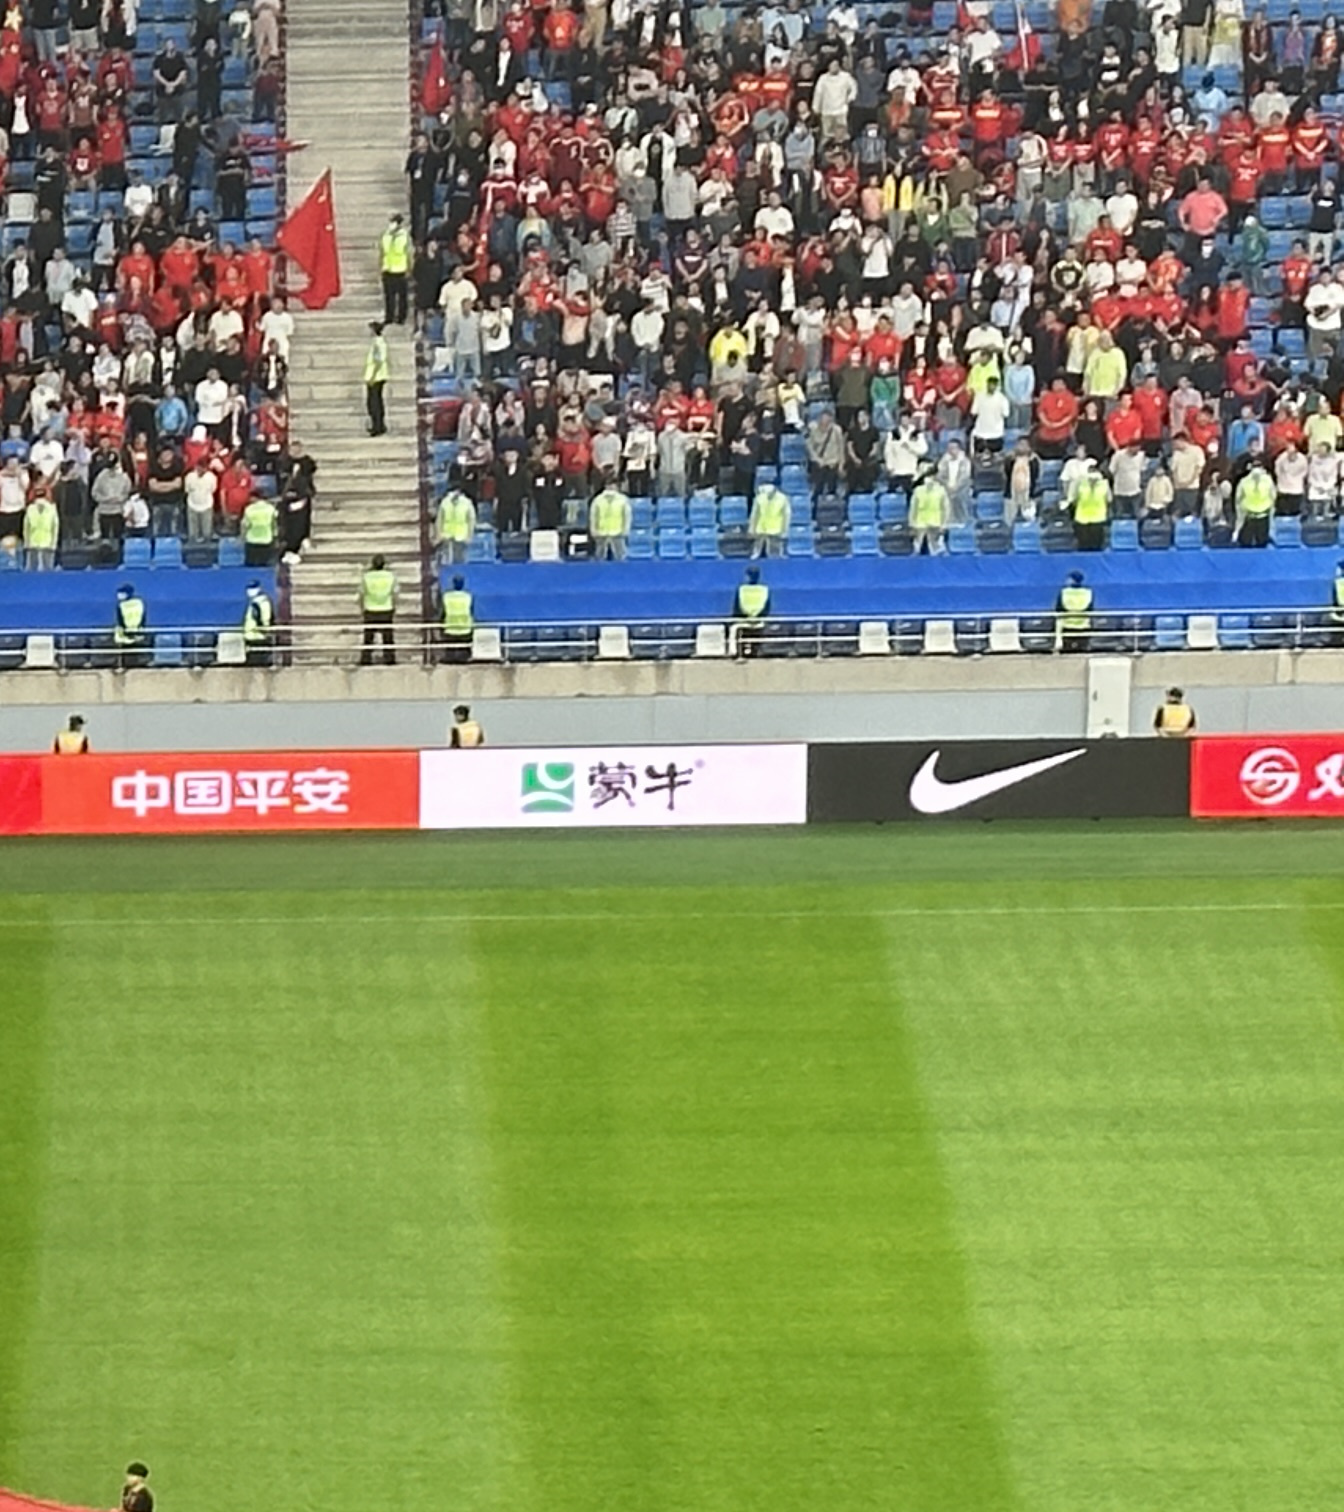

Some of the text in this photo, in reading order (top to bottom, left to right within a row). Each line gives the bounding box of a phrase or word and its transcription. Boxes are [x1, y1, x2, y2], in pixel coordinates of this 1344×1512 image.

[111, 767, 349, 818] 中国平安
[587, 761, 693, 811] 蒙牛
